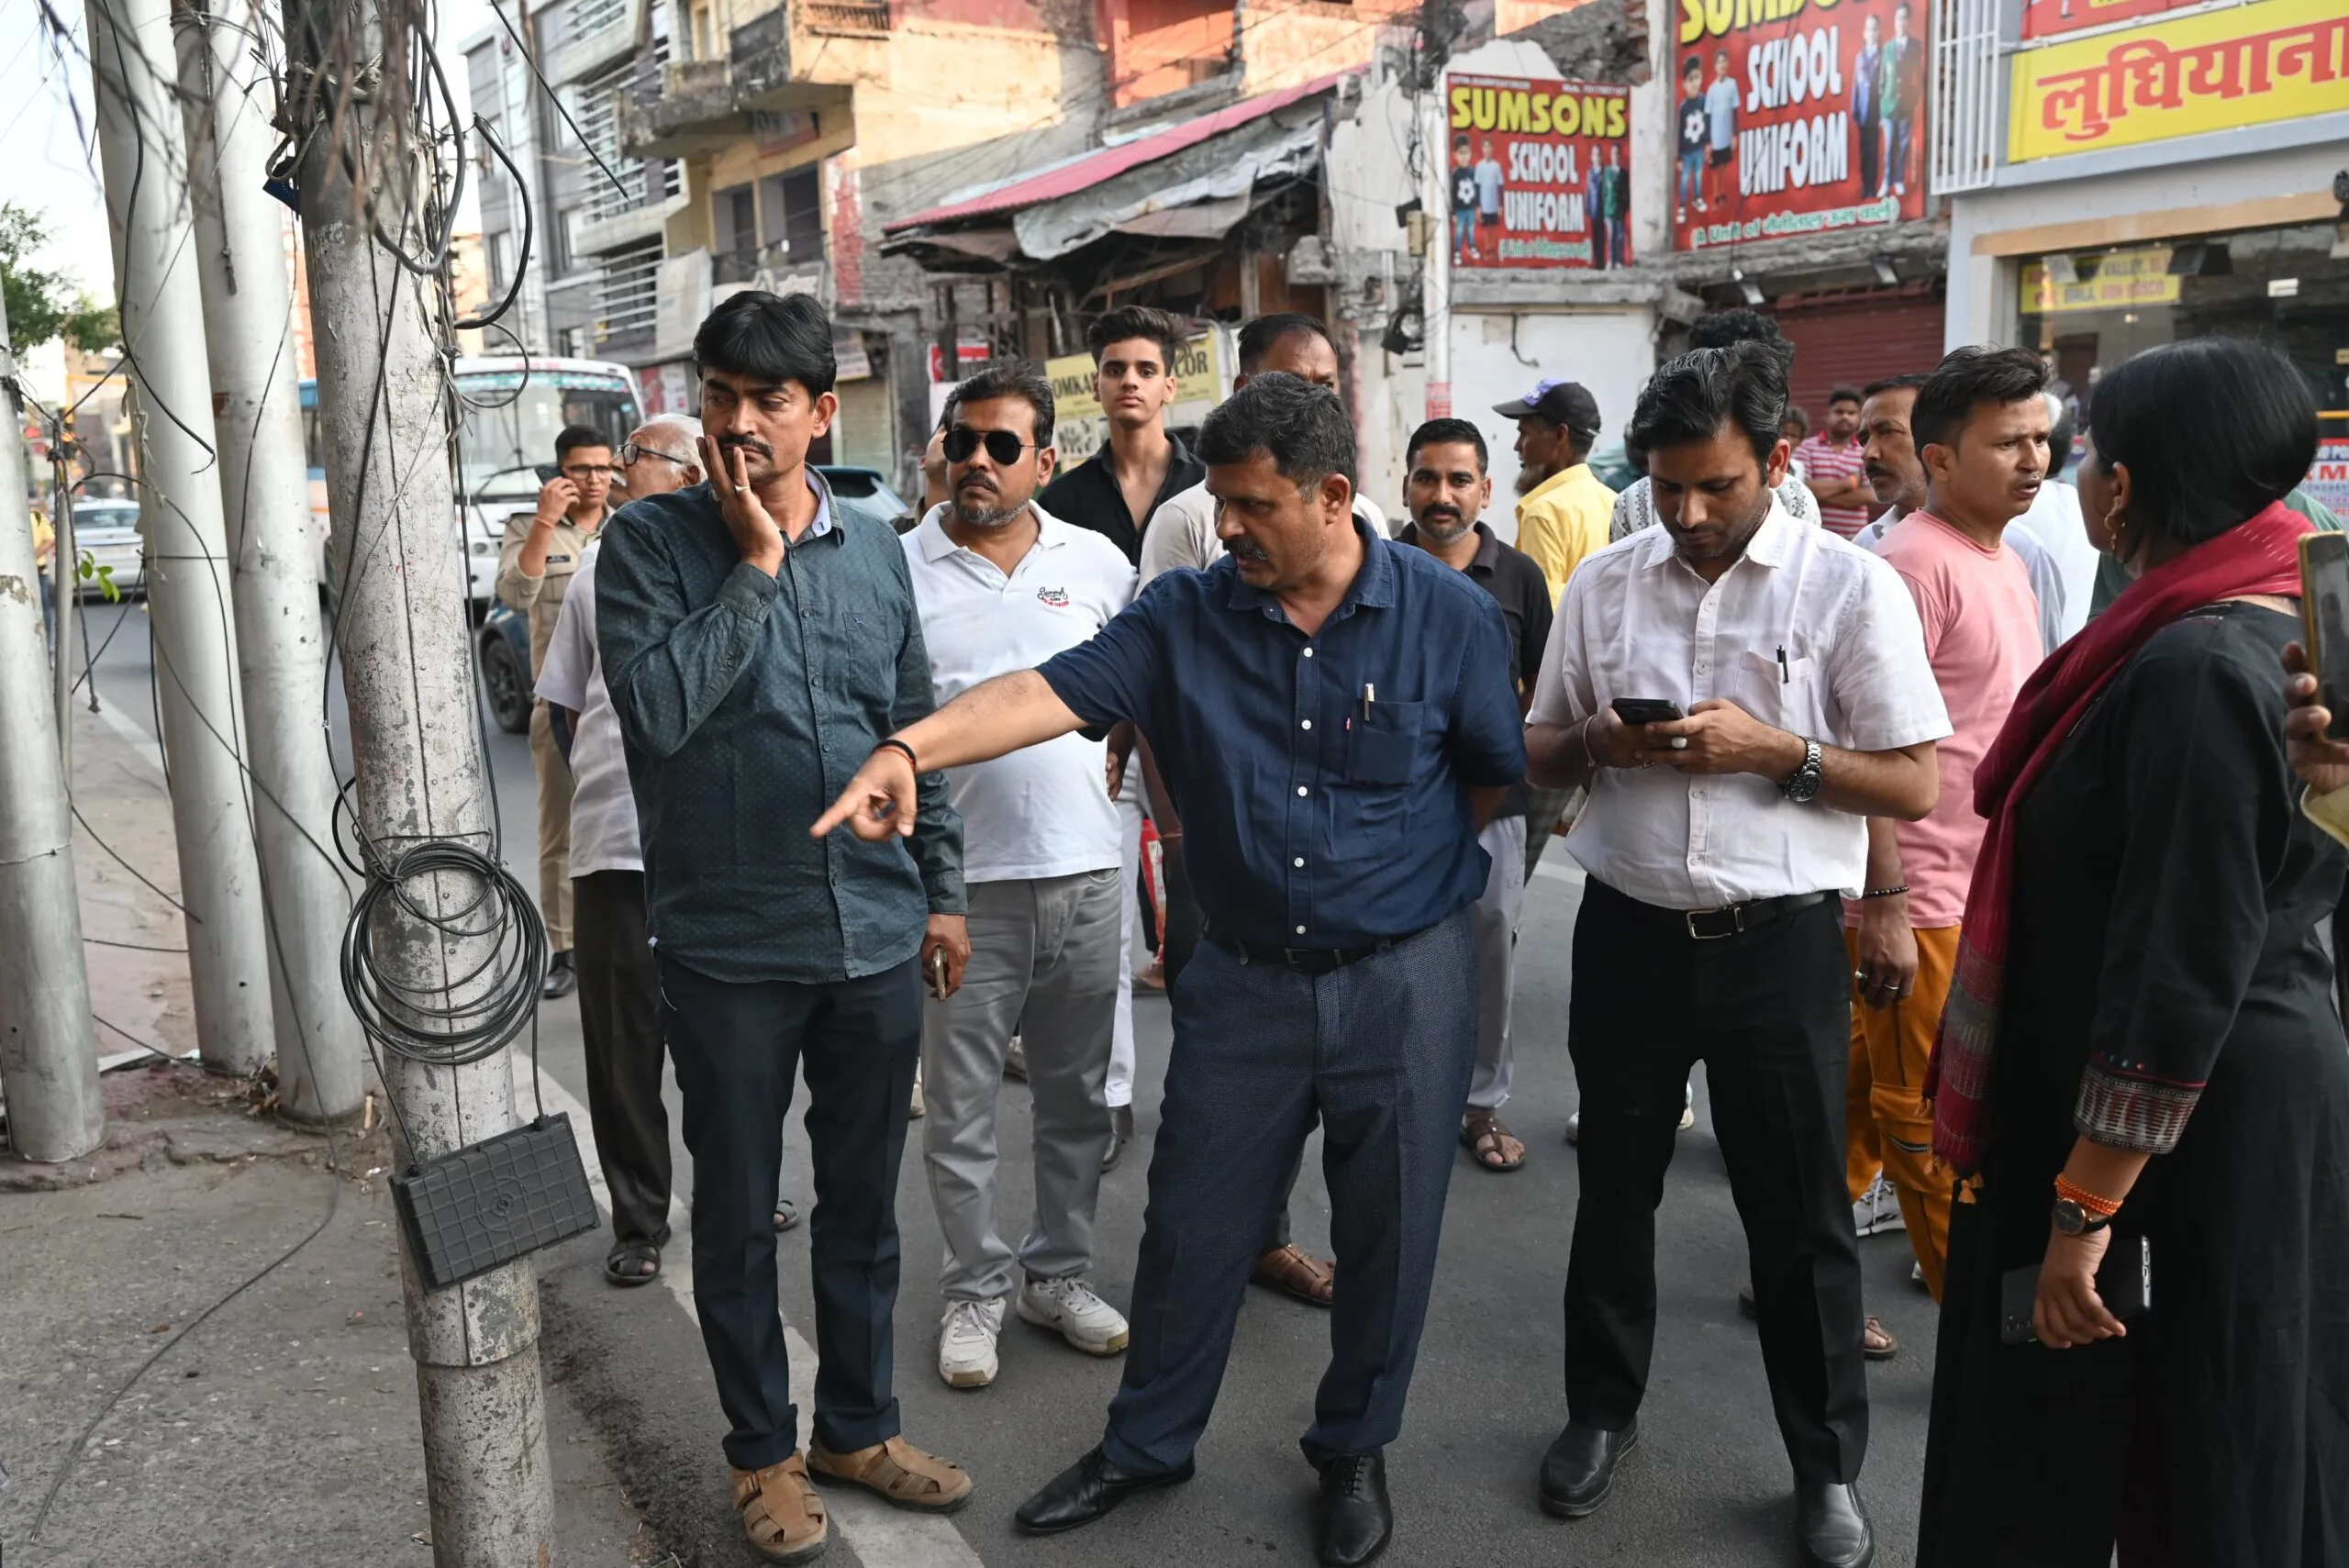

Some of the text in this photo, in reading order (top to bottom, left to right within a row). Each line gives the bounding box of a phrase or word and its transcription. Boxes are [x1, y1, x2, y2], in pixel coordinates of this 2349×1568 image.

[1746, 25, 1842, 114] SCHOOL
[1451, 87, 1628, 138] SUMSONS
[1508, 139, 1578, 184] SCHOOL
[1739, 110, 1848, 196] UNIFORM
[1503, 190, 1585, 232] UNIFORM
[1052, 373, 1093, 398] OMKA
